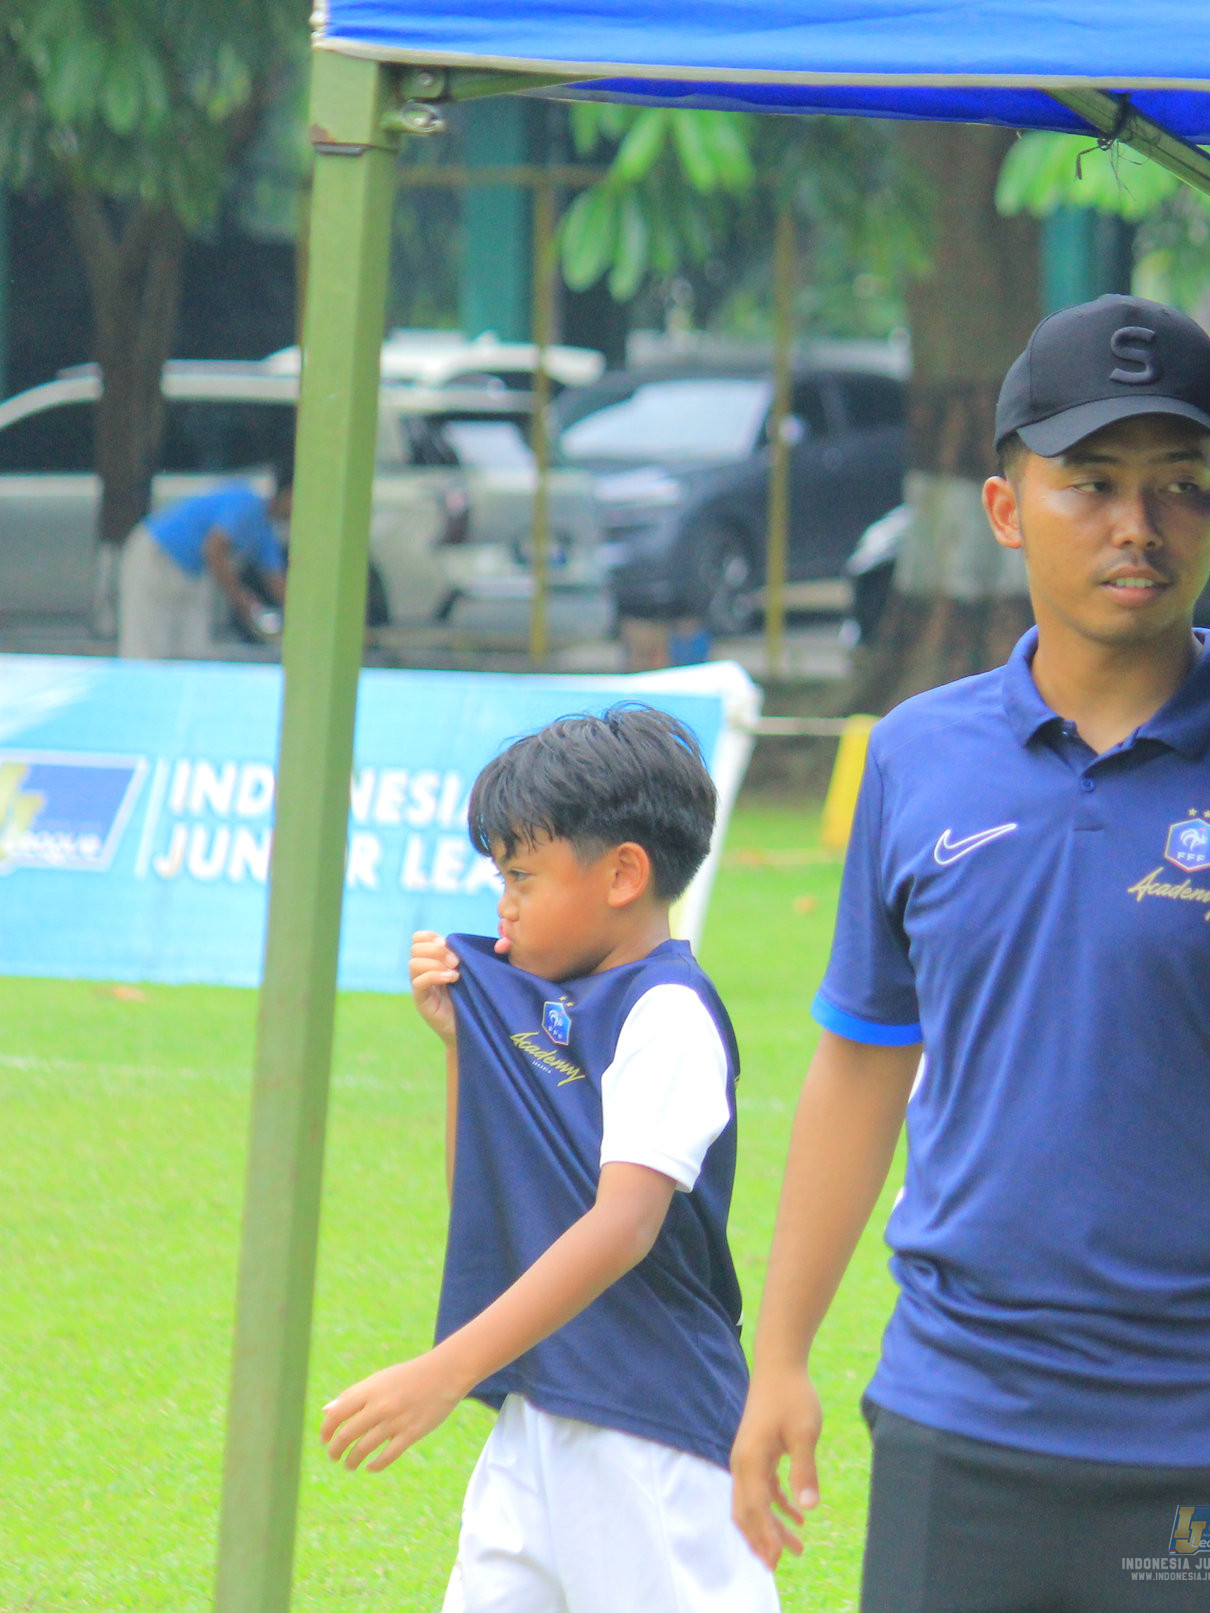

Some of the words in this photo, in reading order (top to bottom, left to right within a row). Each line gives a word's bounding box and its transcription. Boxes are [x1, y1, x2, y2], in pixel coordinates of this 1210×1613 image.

[1109, 325, 1156, 384] S
[168, 757, 470, 830] INDNESI
[153, 820, 381, 892] JUNR
[1176, 851, 1206, 862] FFF
[509, 1031, 586, 1087] Academy
